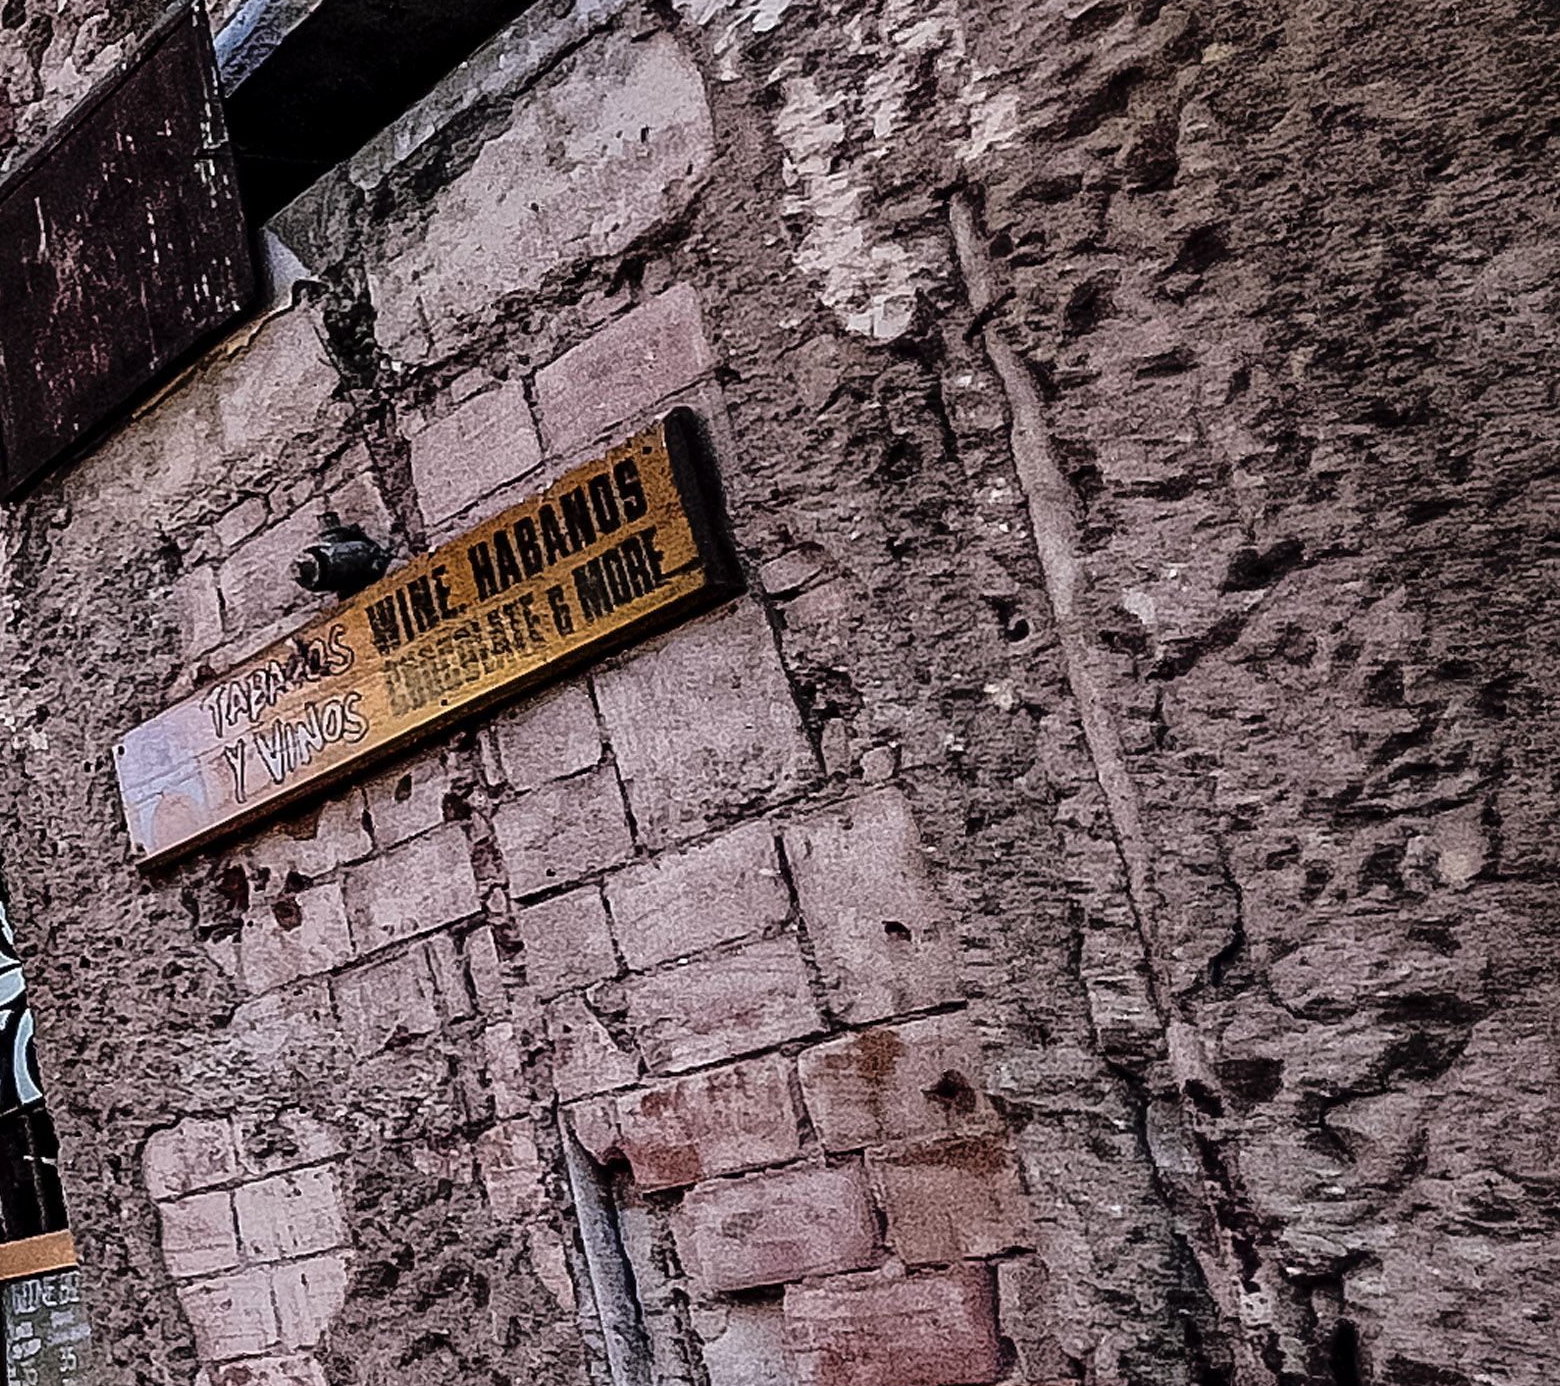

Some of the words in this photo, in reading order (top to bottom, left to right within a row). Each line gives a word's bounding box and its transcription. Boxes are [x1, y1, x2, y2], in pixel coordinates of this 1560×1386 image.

[468, 456, 648, 602] HABANOS
[572, 526, 664, 622] MORE
[224, 739, 246, 804] Y
[254, 691, 370, 785] VINOS
